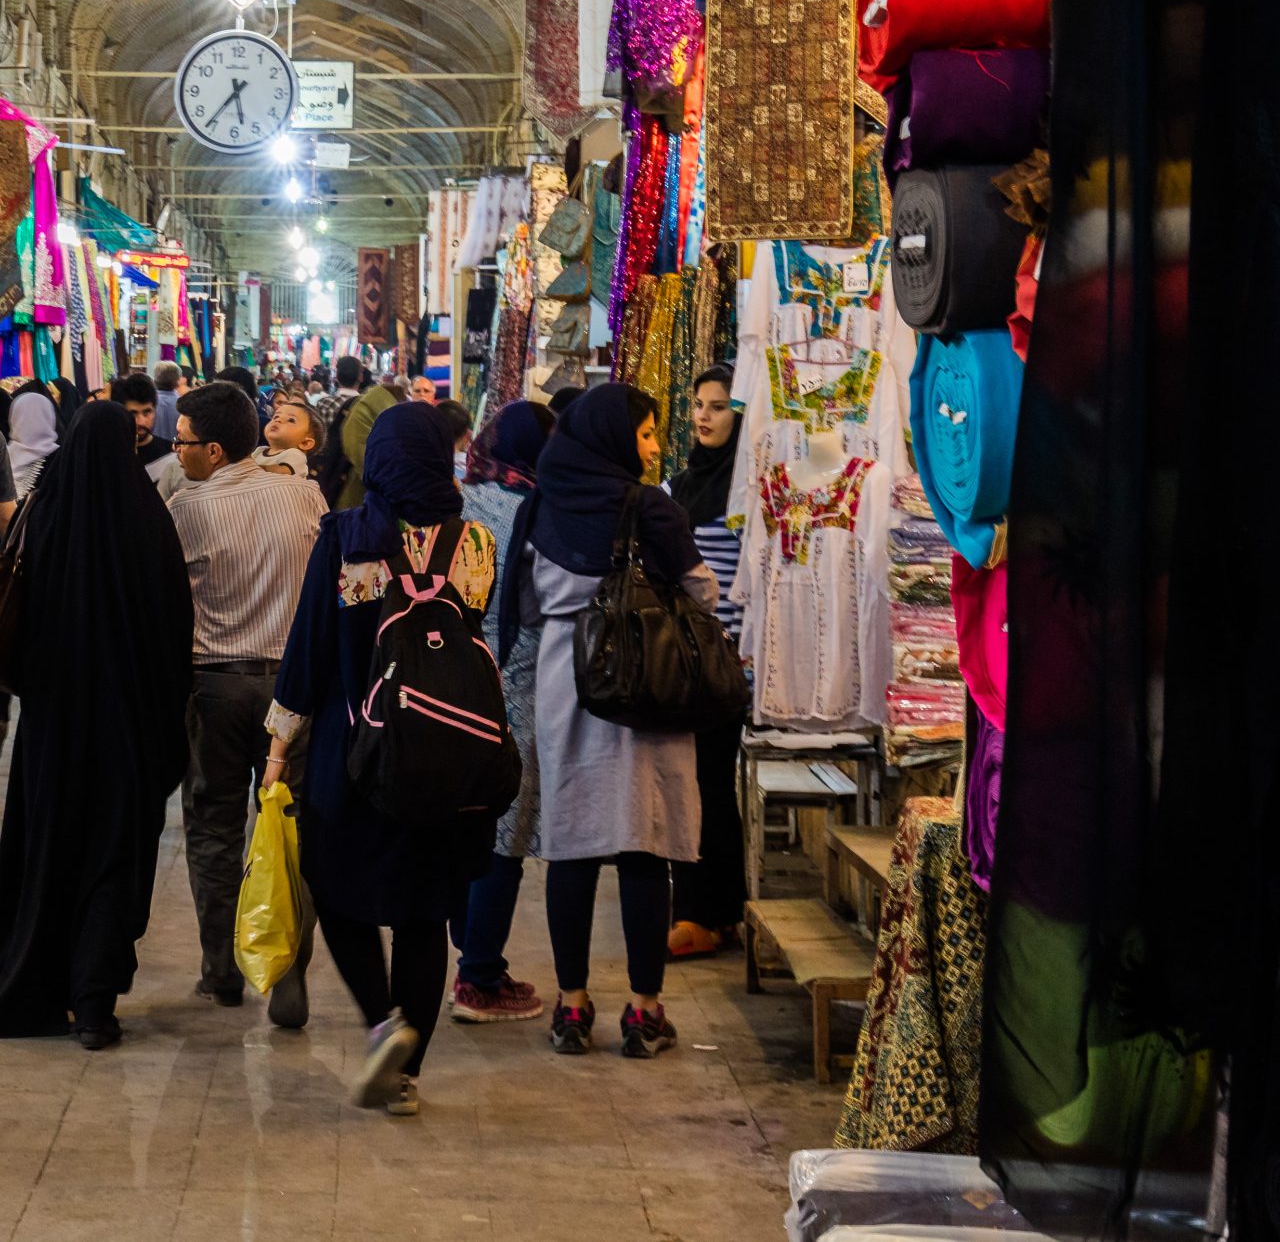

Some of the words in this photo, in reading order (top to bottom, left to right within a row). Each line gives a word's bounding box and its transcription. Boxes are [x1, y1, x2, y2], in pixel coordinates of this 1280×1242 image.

[212, 52, 224, 64] 11
[231, 46, 246, 58] 12
[257, 53, 263, 65] 1
[198, 65, 213, 78] 10
[270, 67, 279, 79] 2
[190, 85, 200, 98] 9
[274, 88, 284, 100] 3
[195, 105, 205, 118] 8
[267, 108, 278, 119] 4
[305, 112, 335, 122] Place
[230, 126, 240, 139] 6
[251, 121, 261, 134] 5
